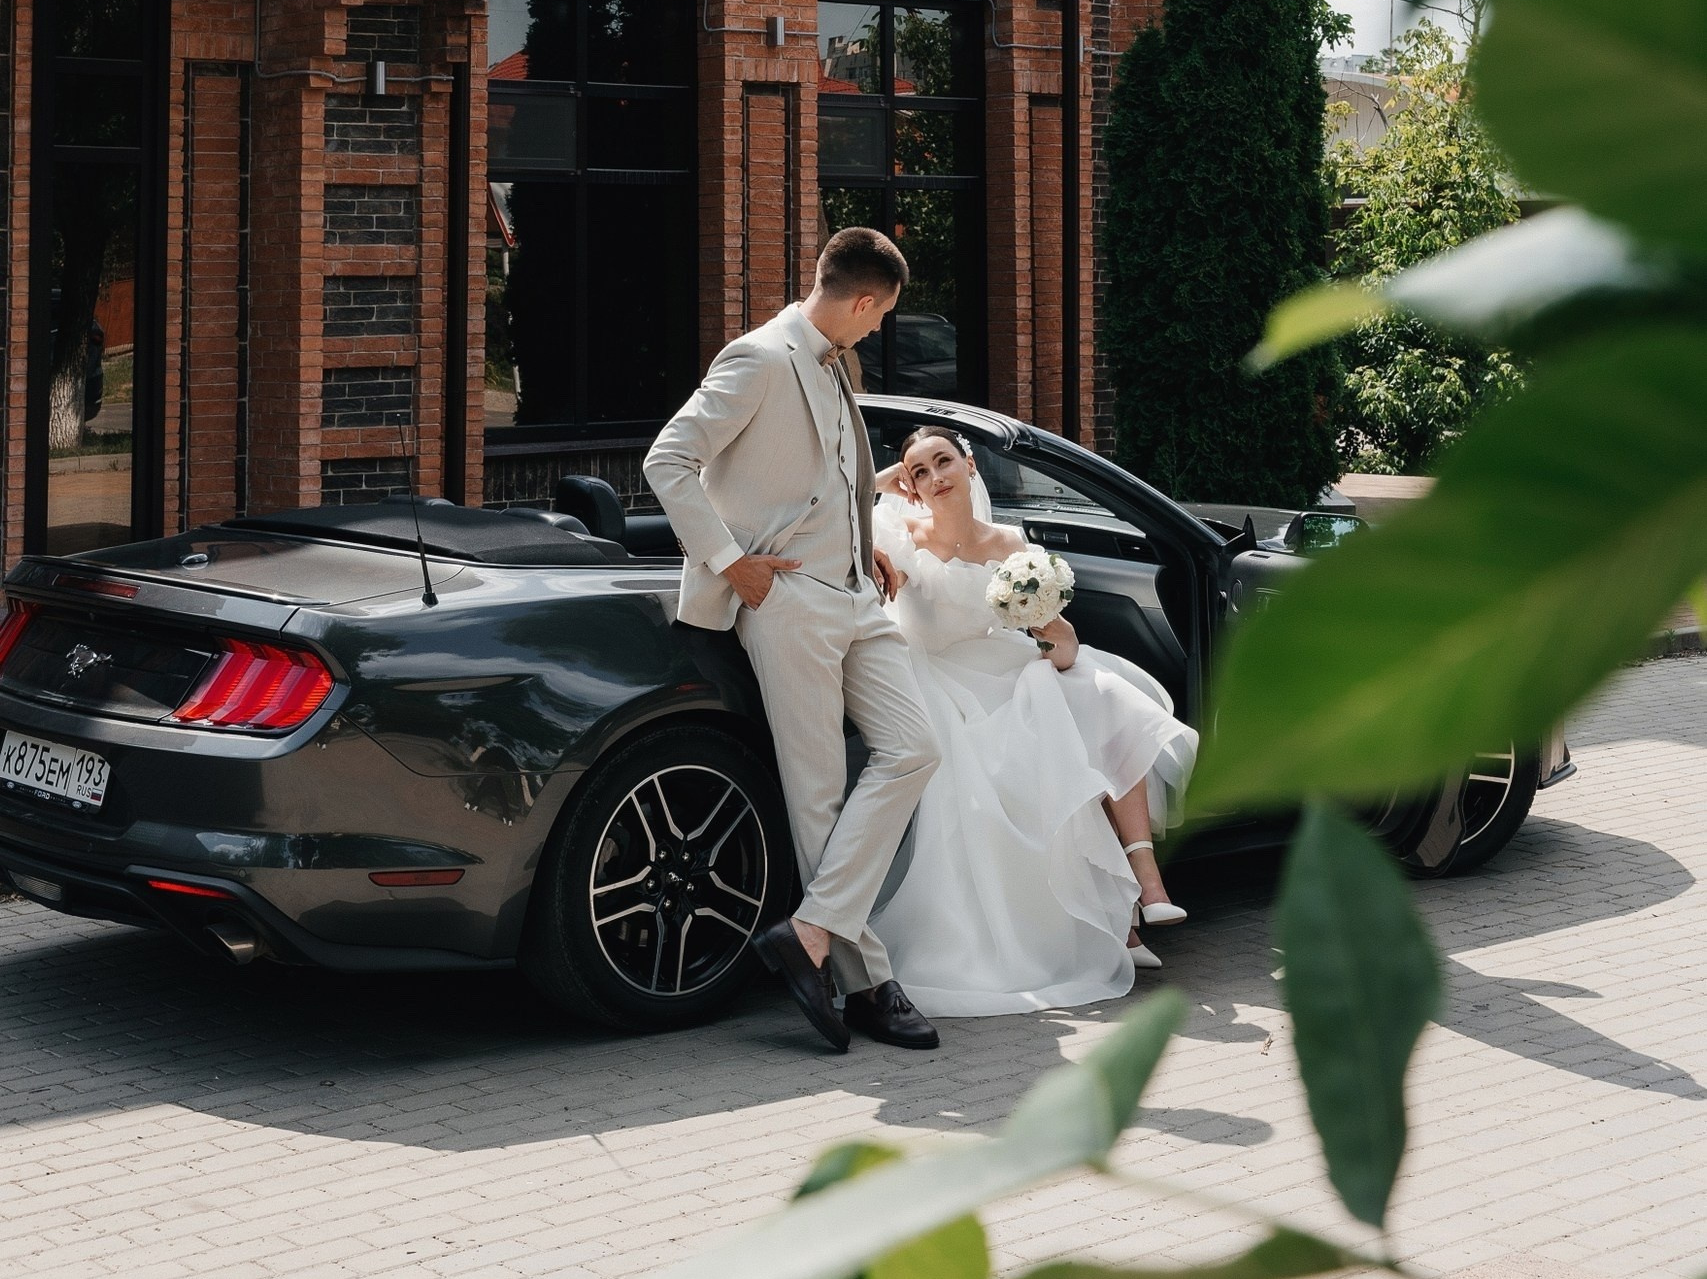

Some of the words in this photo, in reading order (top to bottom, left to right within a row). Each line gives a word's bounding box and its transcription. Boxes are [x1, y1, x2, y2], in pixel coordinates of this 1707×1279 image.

[76, 753, 106, 787] 193
[34, 789, 51, 800] FORD
[76, 784, 92, 798] RUS
